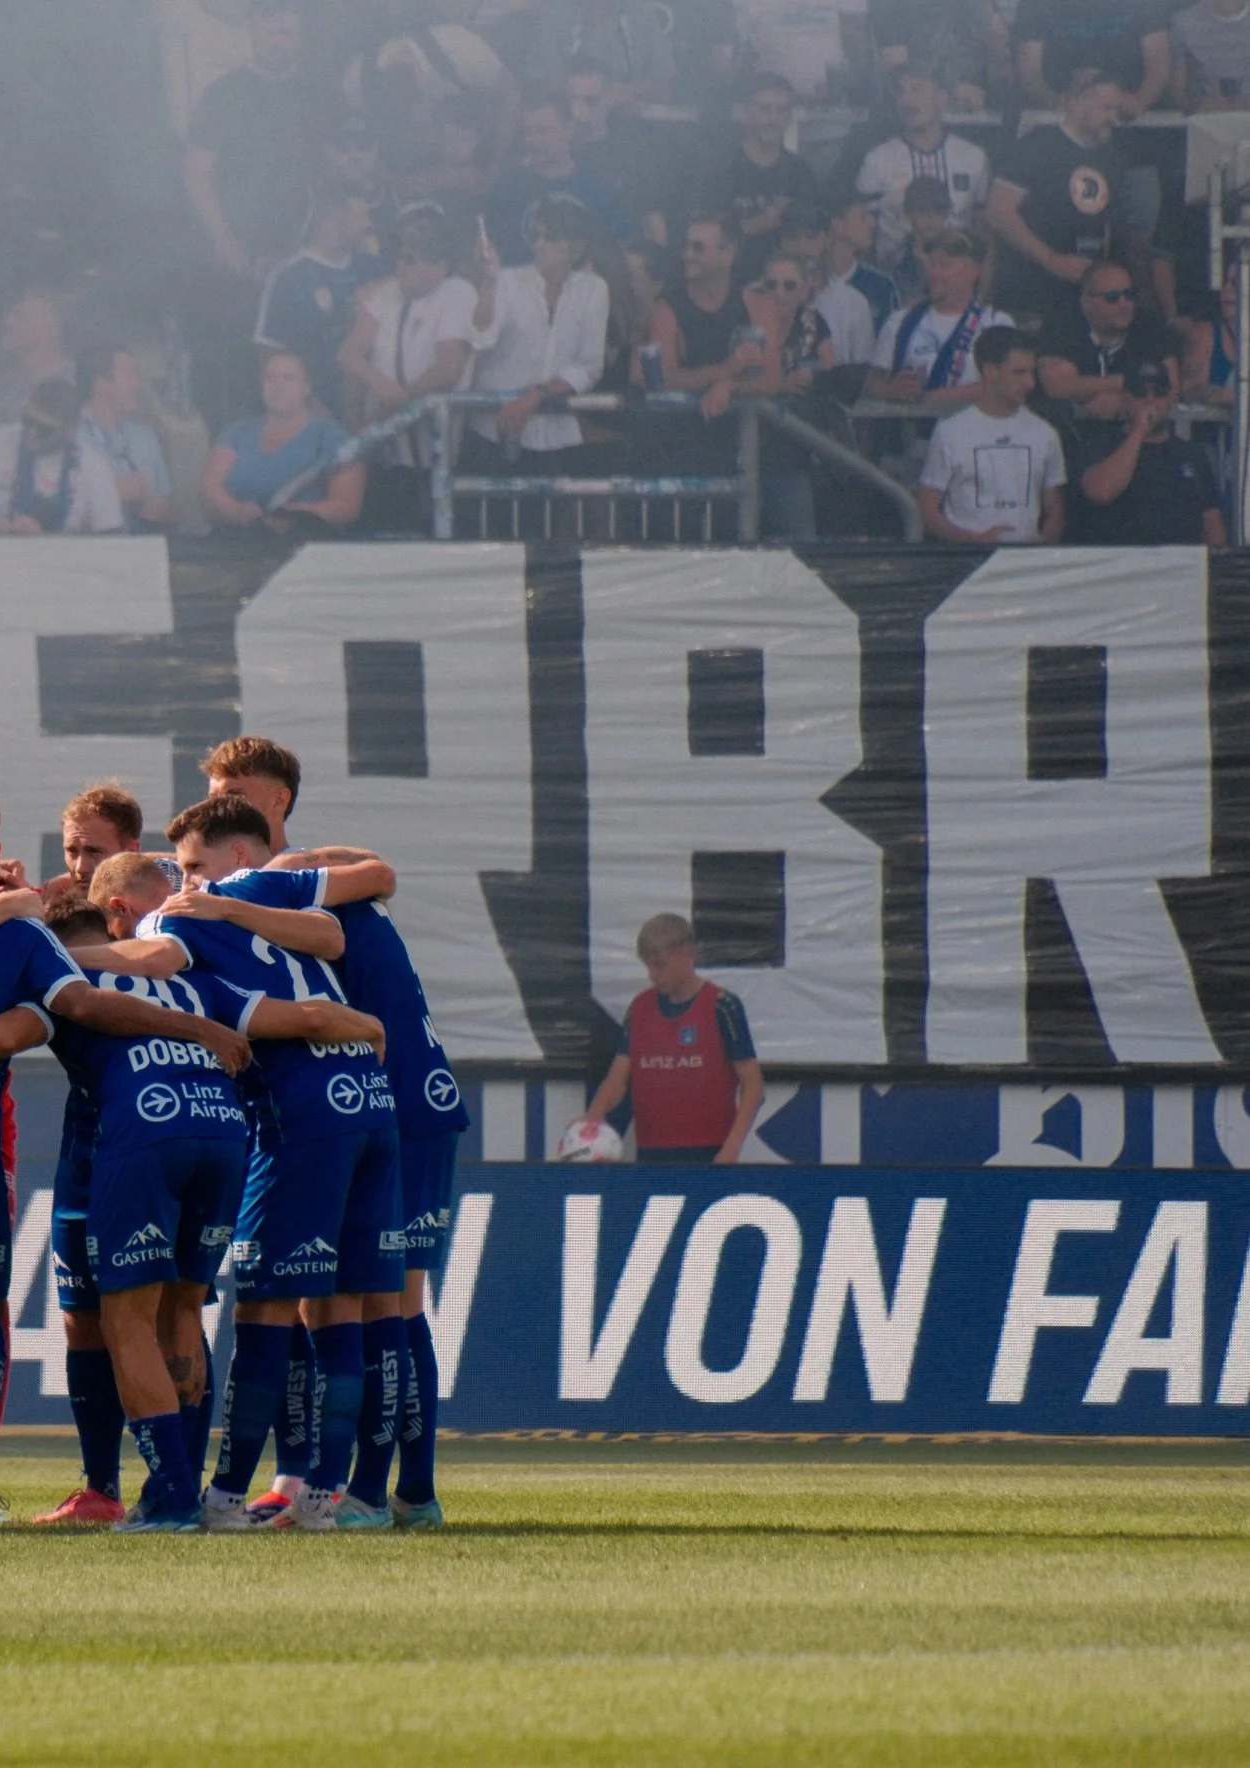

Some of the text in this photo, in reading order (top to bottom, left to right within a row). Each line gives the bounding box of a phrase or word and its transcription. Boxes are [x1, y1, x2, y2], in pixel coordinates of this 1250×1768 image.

[181, 1081, 225, 1101] Linz
[361, 1071, 390, 1090] Linz
[558, 1193, 947, 1404] VON
[986, 1199, 1250, 1405] FA
[286, 1358, 308, 1425] LIWEST
[380, 1348, 400, 1418] LIWEST
